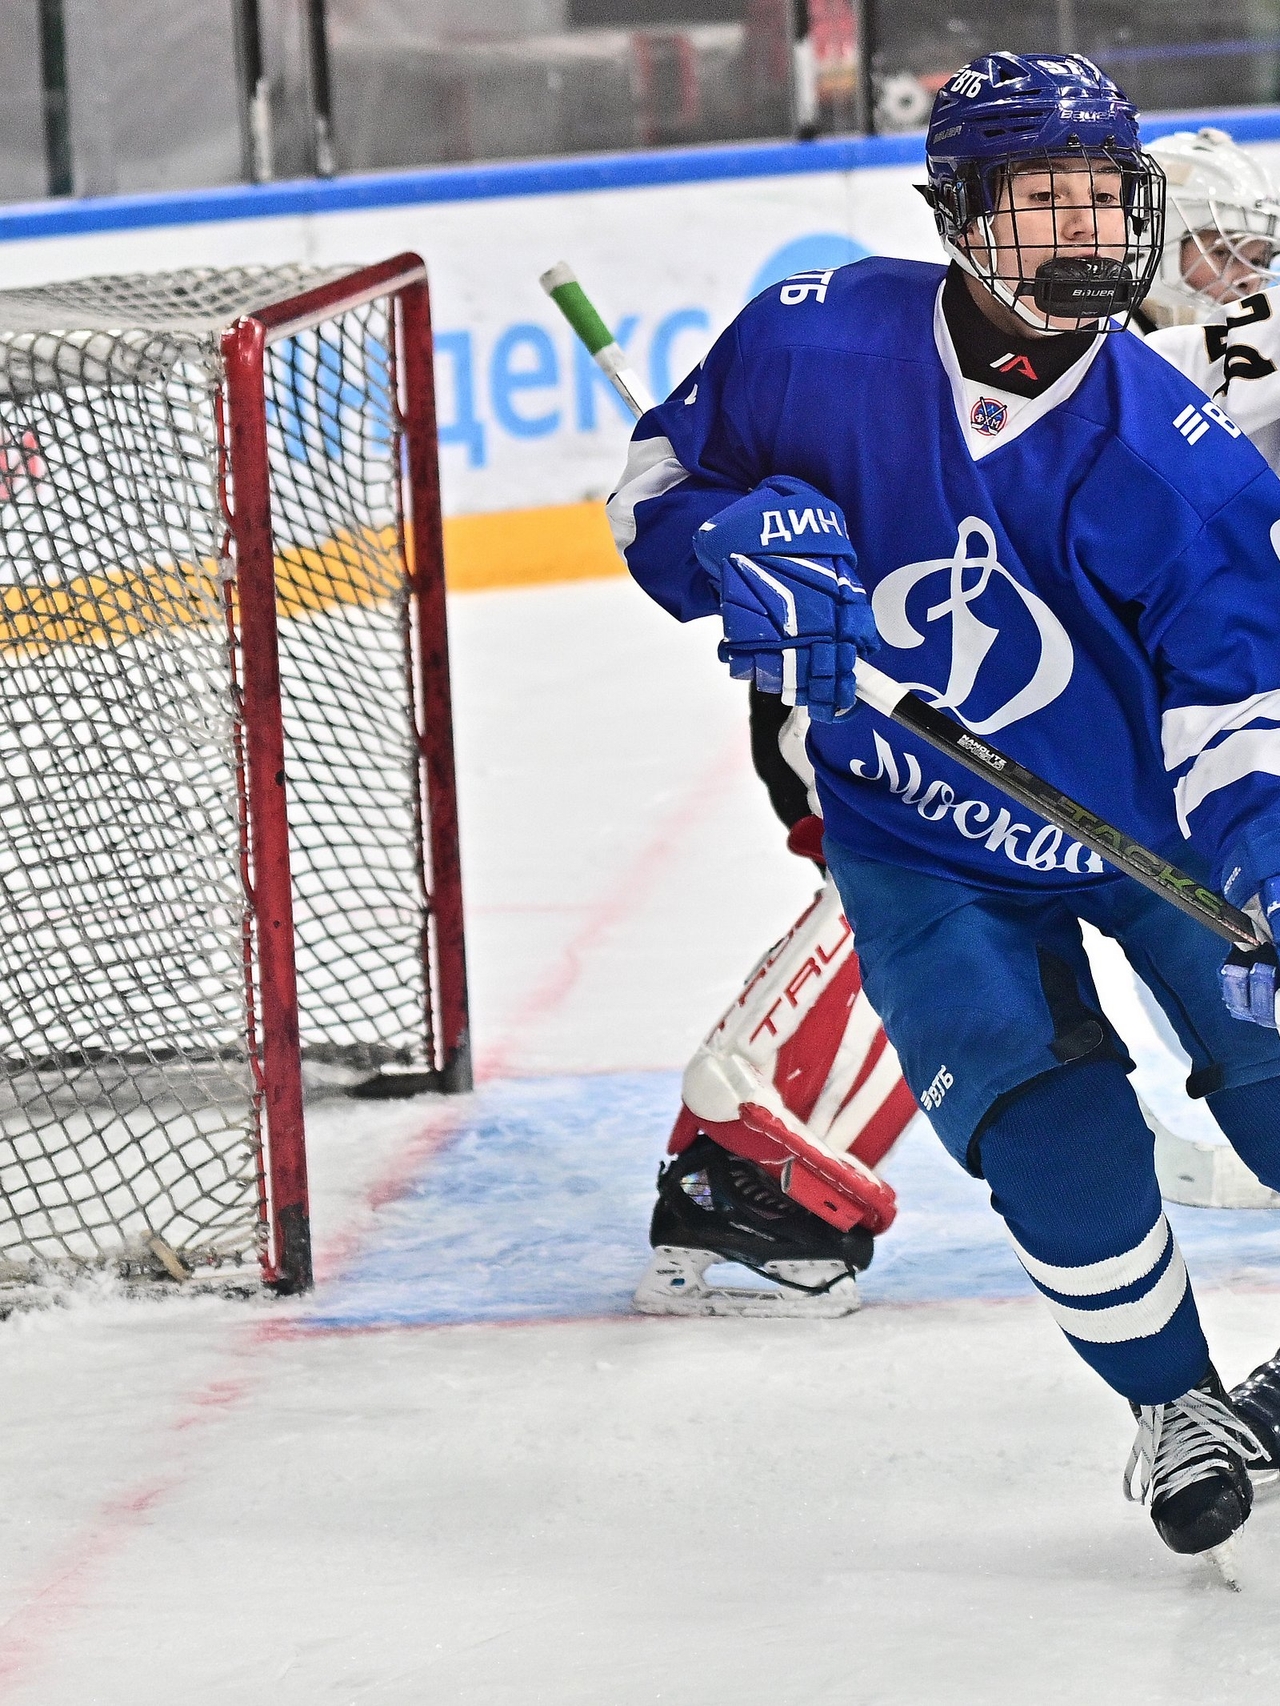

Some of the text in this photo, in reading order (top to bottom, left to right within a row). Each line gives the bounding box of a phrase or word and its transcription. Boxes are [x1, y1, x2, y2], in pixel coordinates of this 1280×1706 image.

[950, 68, 990, 98] ВТБ
[974, 413, 1001, 429] ФХМ
[961, 734, 1008, 765] NANOLITE
[850, 729, 1104, 875] Москва
[927, 1064, 954, 1108] ВТБ
